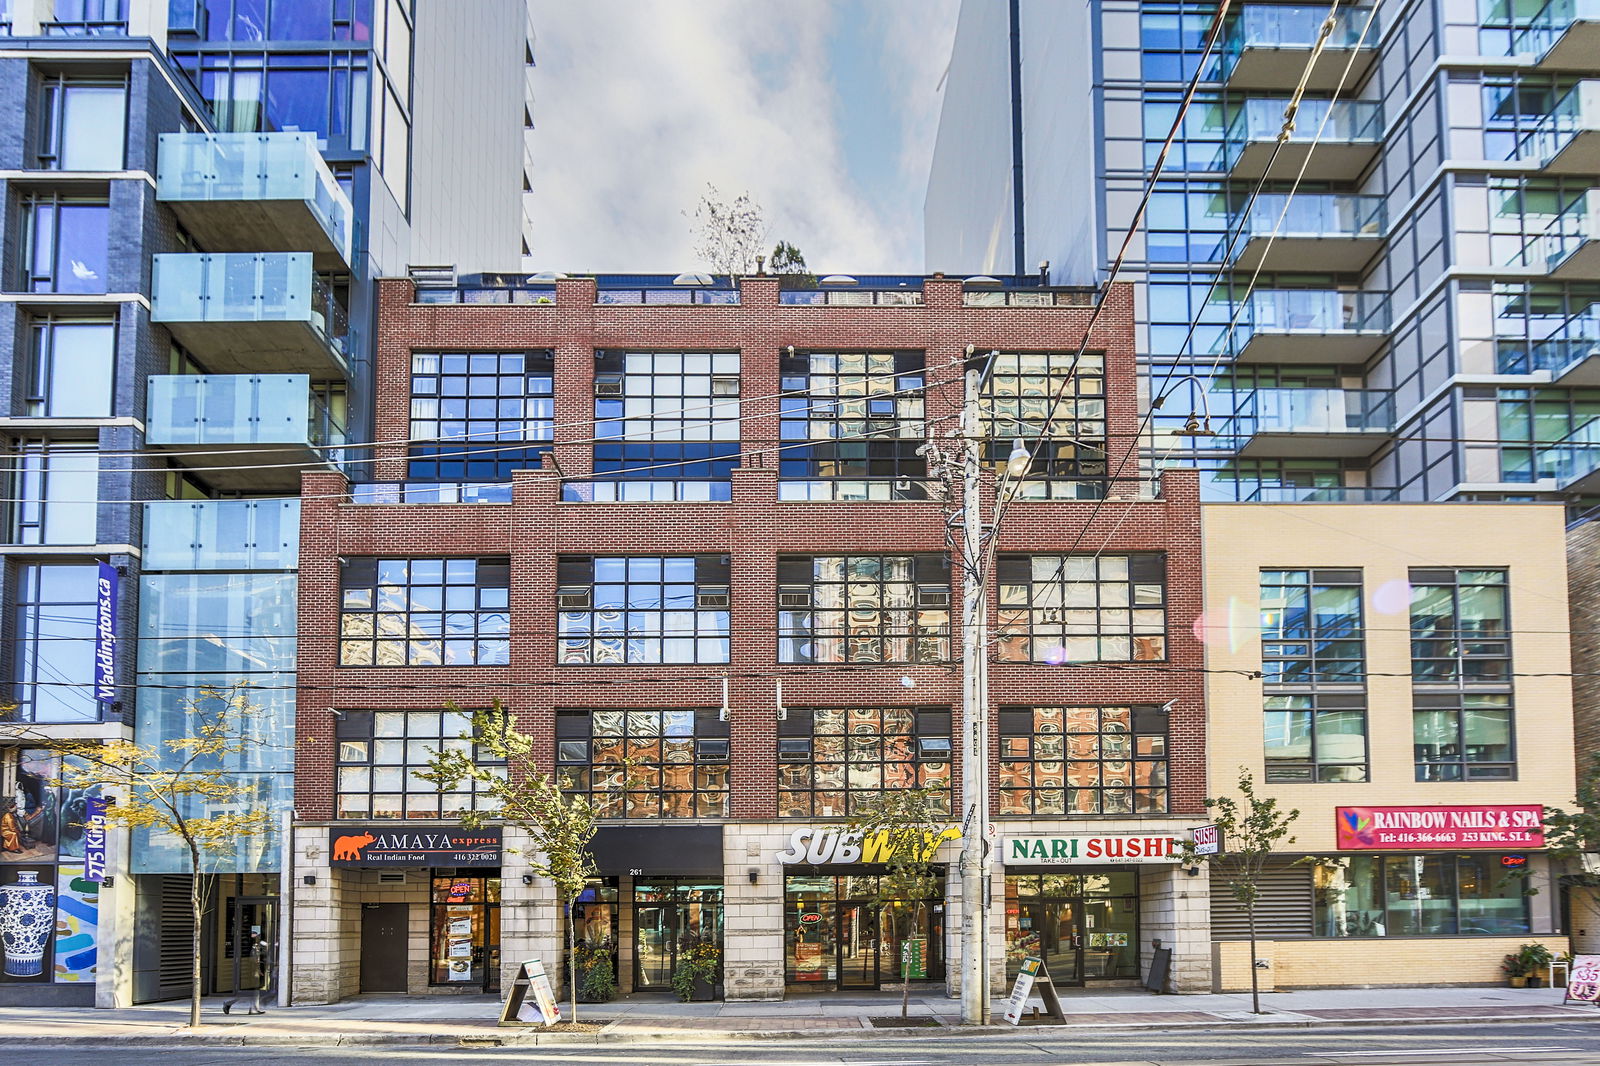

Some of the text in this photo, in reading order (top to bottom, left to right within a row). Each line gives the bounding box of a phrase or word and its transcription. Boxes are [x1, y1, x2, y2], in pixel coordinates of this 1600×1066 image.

[97, 578, 116, 698] Waddingtons.ca
[1373, 811, 1540, 829] RAINBOW NAILS & SPA
[375, 834, 497, 849] AMAYA express
[1194, 827, 1217, 845] SUSHI
[1379, 832, 1396, 843] Tel:
[1462, 832, 1478, 842] 253
[87, 815, 107, 879] 275 King
[1012, 837, 1175, 858] NARI SUSHI
[367, 853, 425, 861] Real Indian Food
[453, 853, 466, 861] 416
[629, 868, 643, 876] 261
[450, 885, 470, 894] OPEN
[802, 914, 820, 922] OPEN
